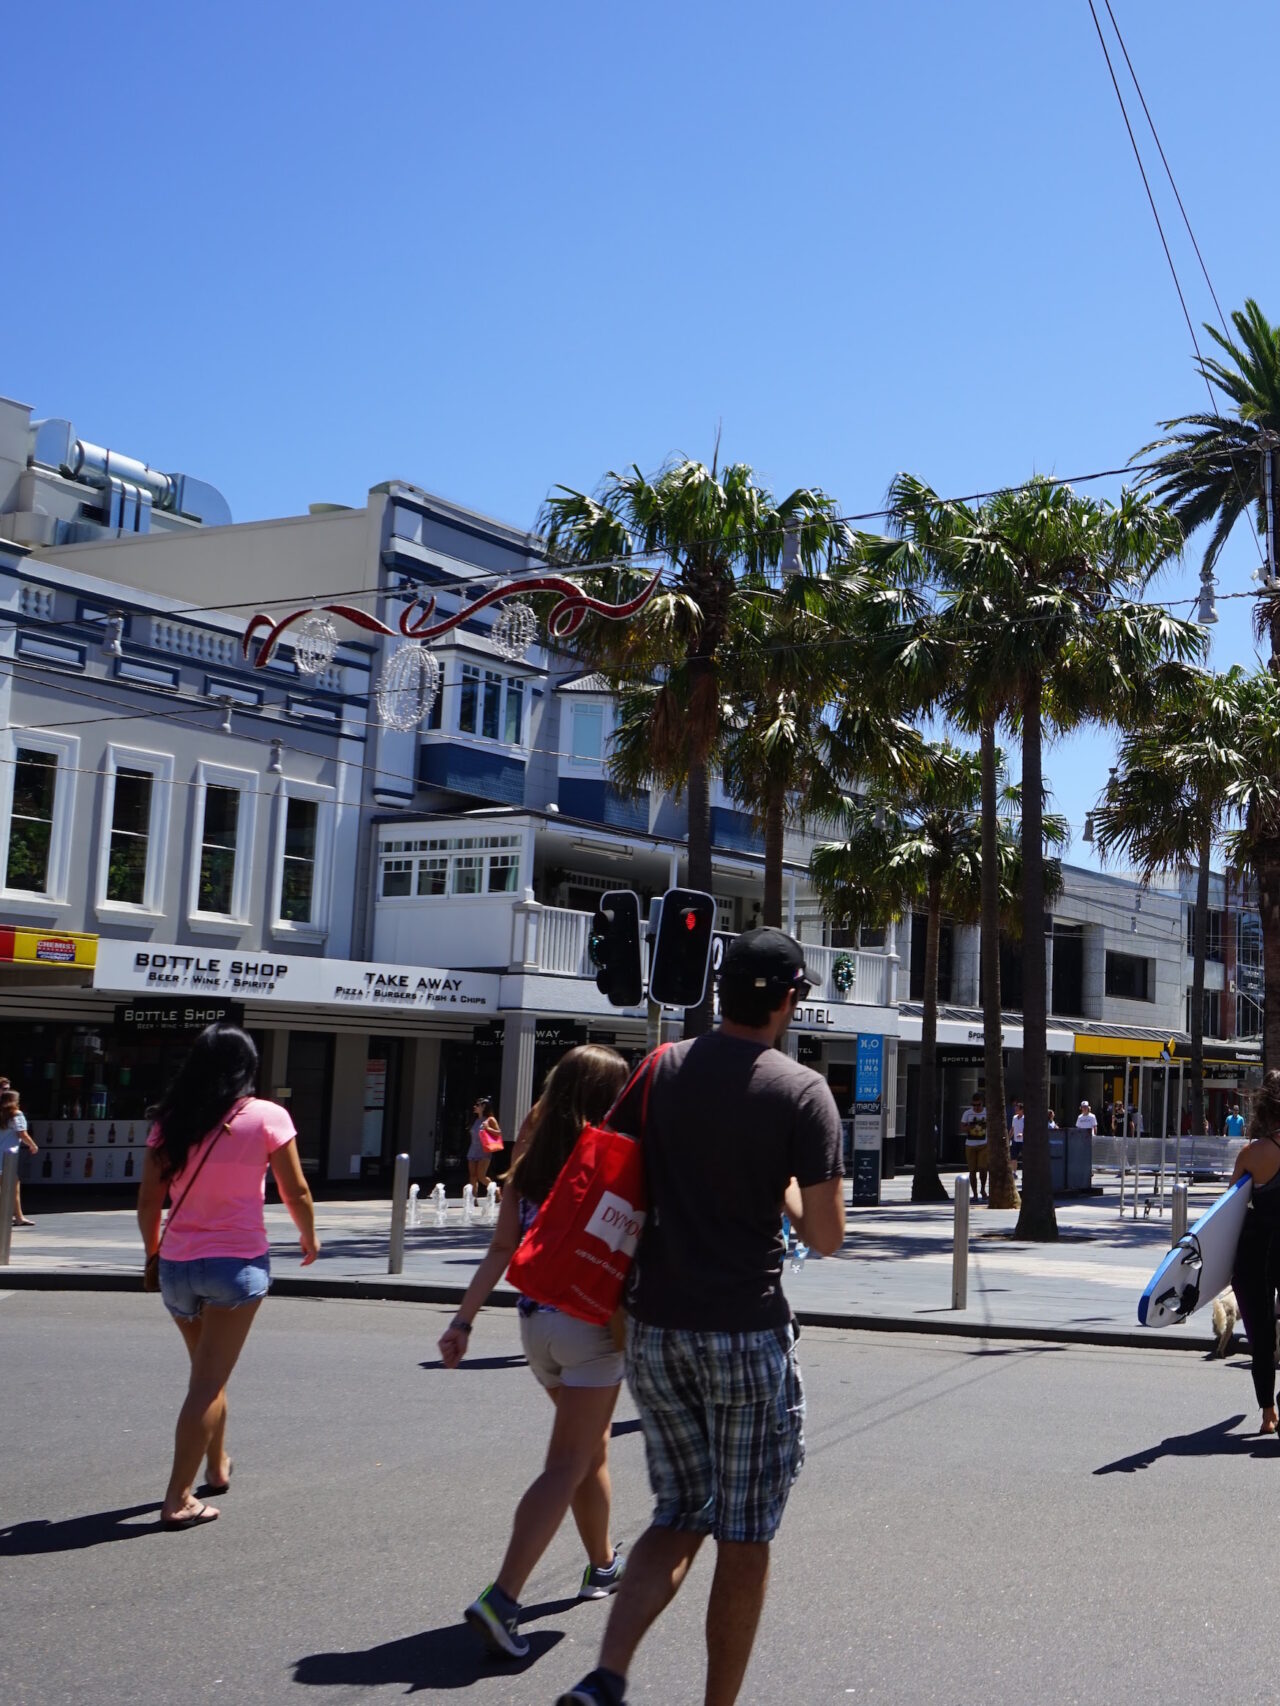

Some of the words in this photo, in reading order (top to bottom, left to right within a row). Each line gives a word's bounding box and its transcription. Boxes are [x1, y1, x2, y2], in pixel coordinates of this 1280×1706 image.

[37, 941, 76, 950] CHEMIST
[135, 953, 221, 972] BOTTLE
[230, 961, 288, 977] SHOP
[365, 972, 409, 988] TAKE
[417, 977, 463, 991] AWAY
[124, 1009, 178, 1022] BOTTLE
[184, 1008, 226, 1021] SHOP
[792, 1007, 835, 1024] OTEL
[535, 1030, 560, 1038] WAY
[856, 1102, 880, 1112] manly
[601, 1206, 642, 1240] DYMO
